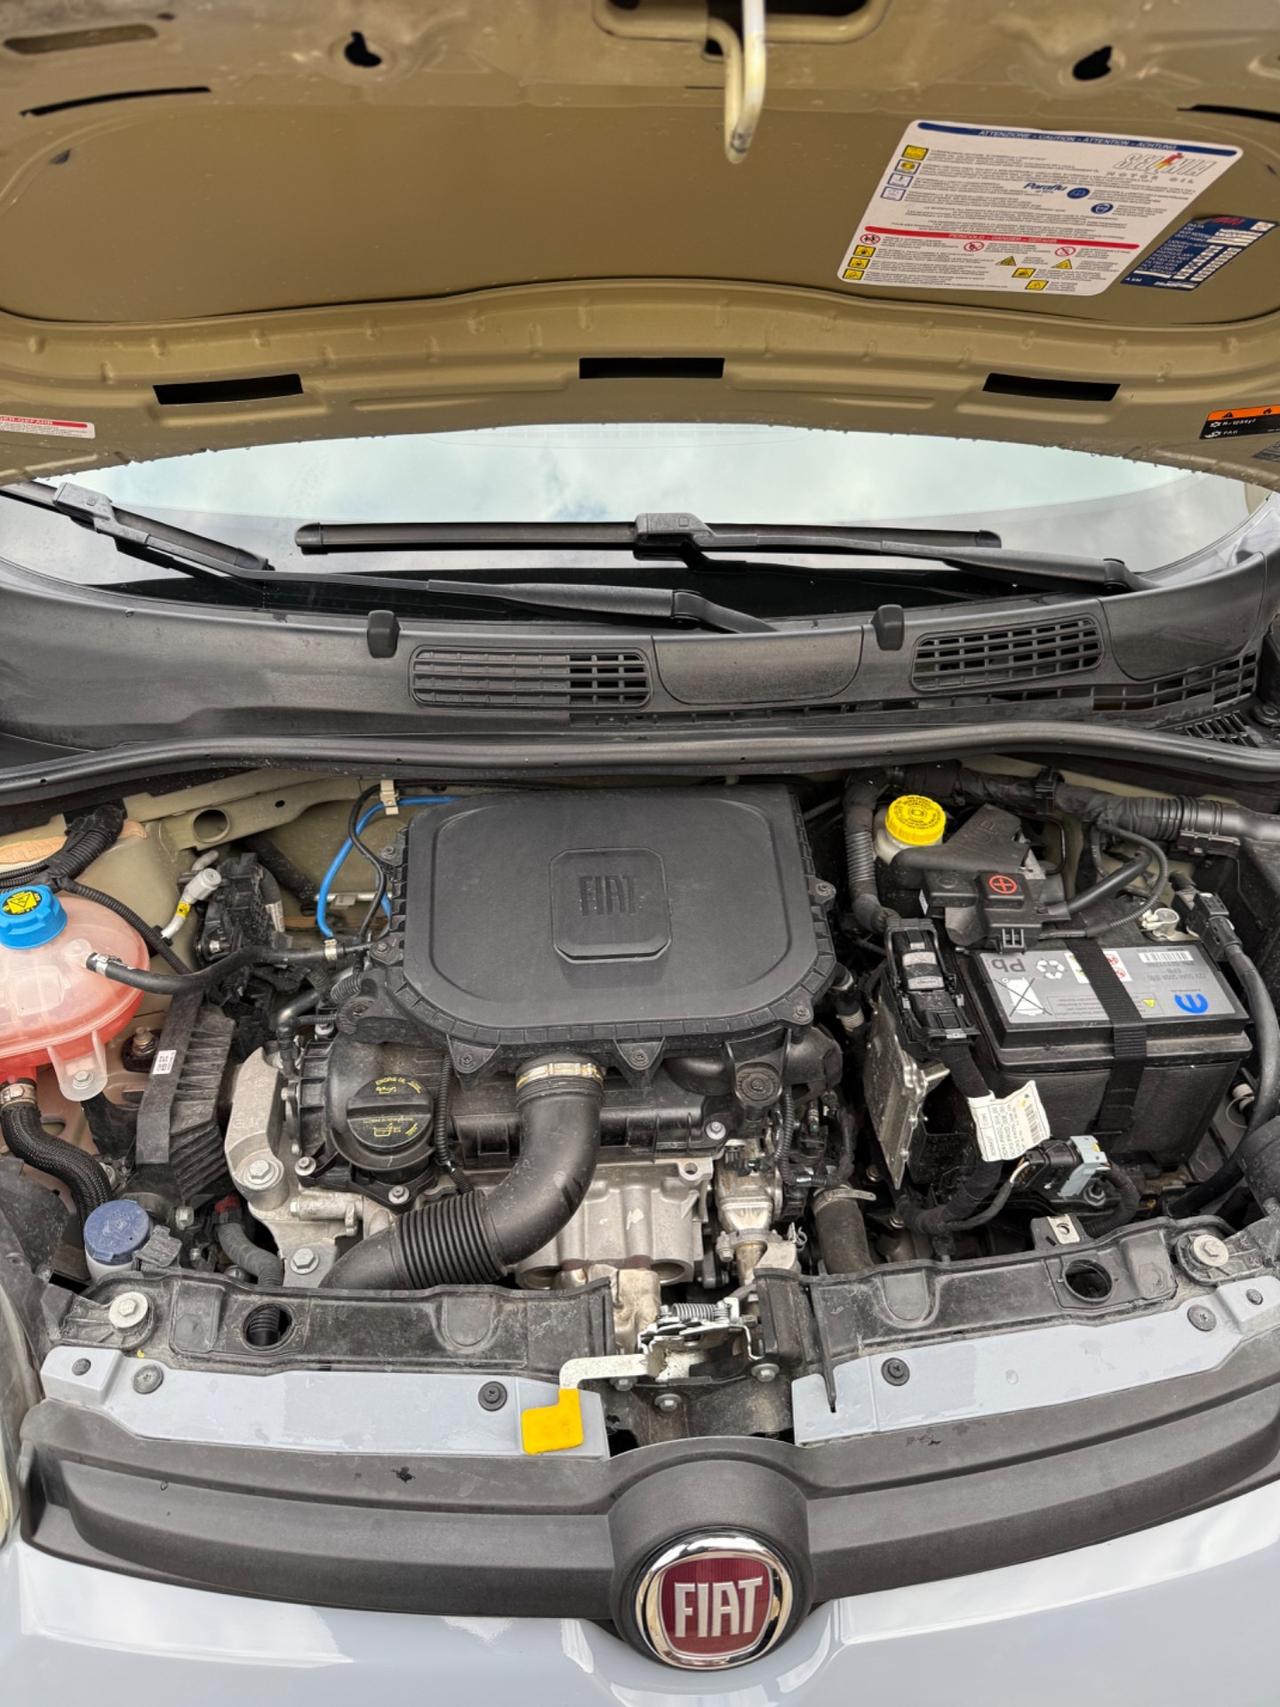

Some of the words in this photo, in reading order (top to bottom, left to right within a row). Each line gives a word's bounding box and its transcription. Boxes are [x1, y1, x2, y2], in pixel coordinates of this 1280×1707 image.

[1039, 133, 1075, 142] CAUTION
[1083, 137, 1130, 147] ATTENTION
[579, 876, 637, 917] FIAT
[992, 959, 1026, 973] Pb
[674, 1576, 764, 1638] FIAT
